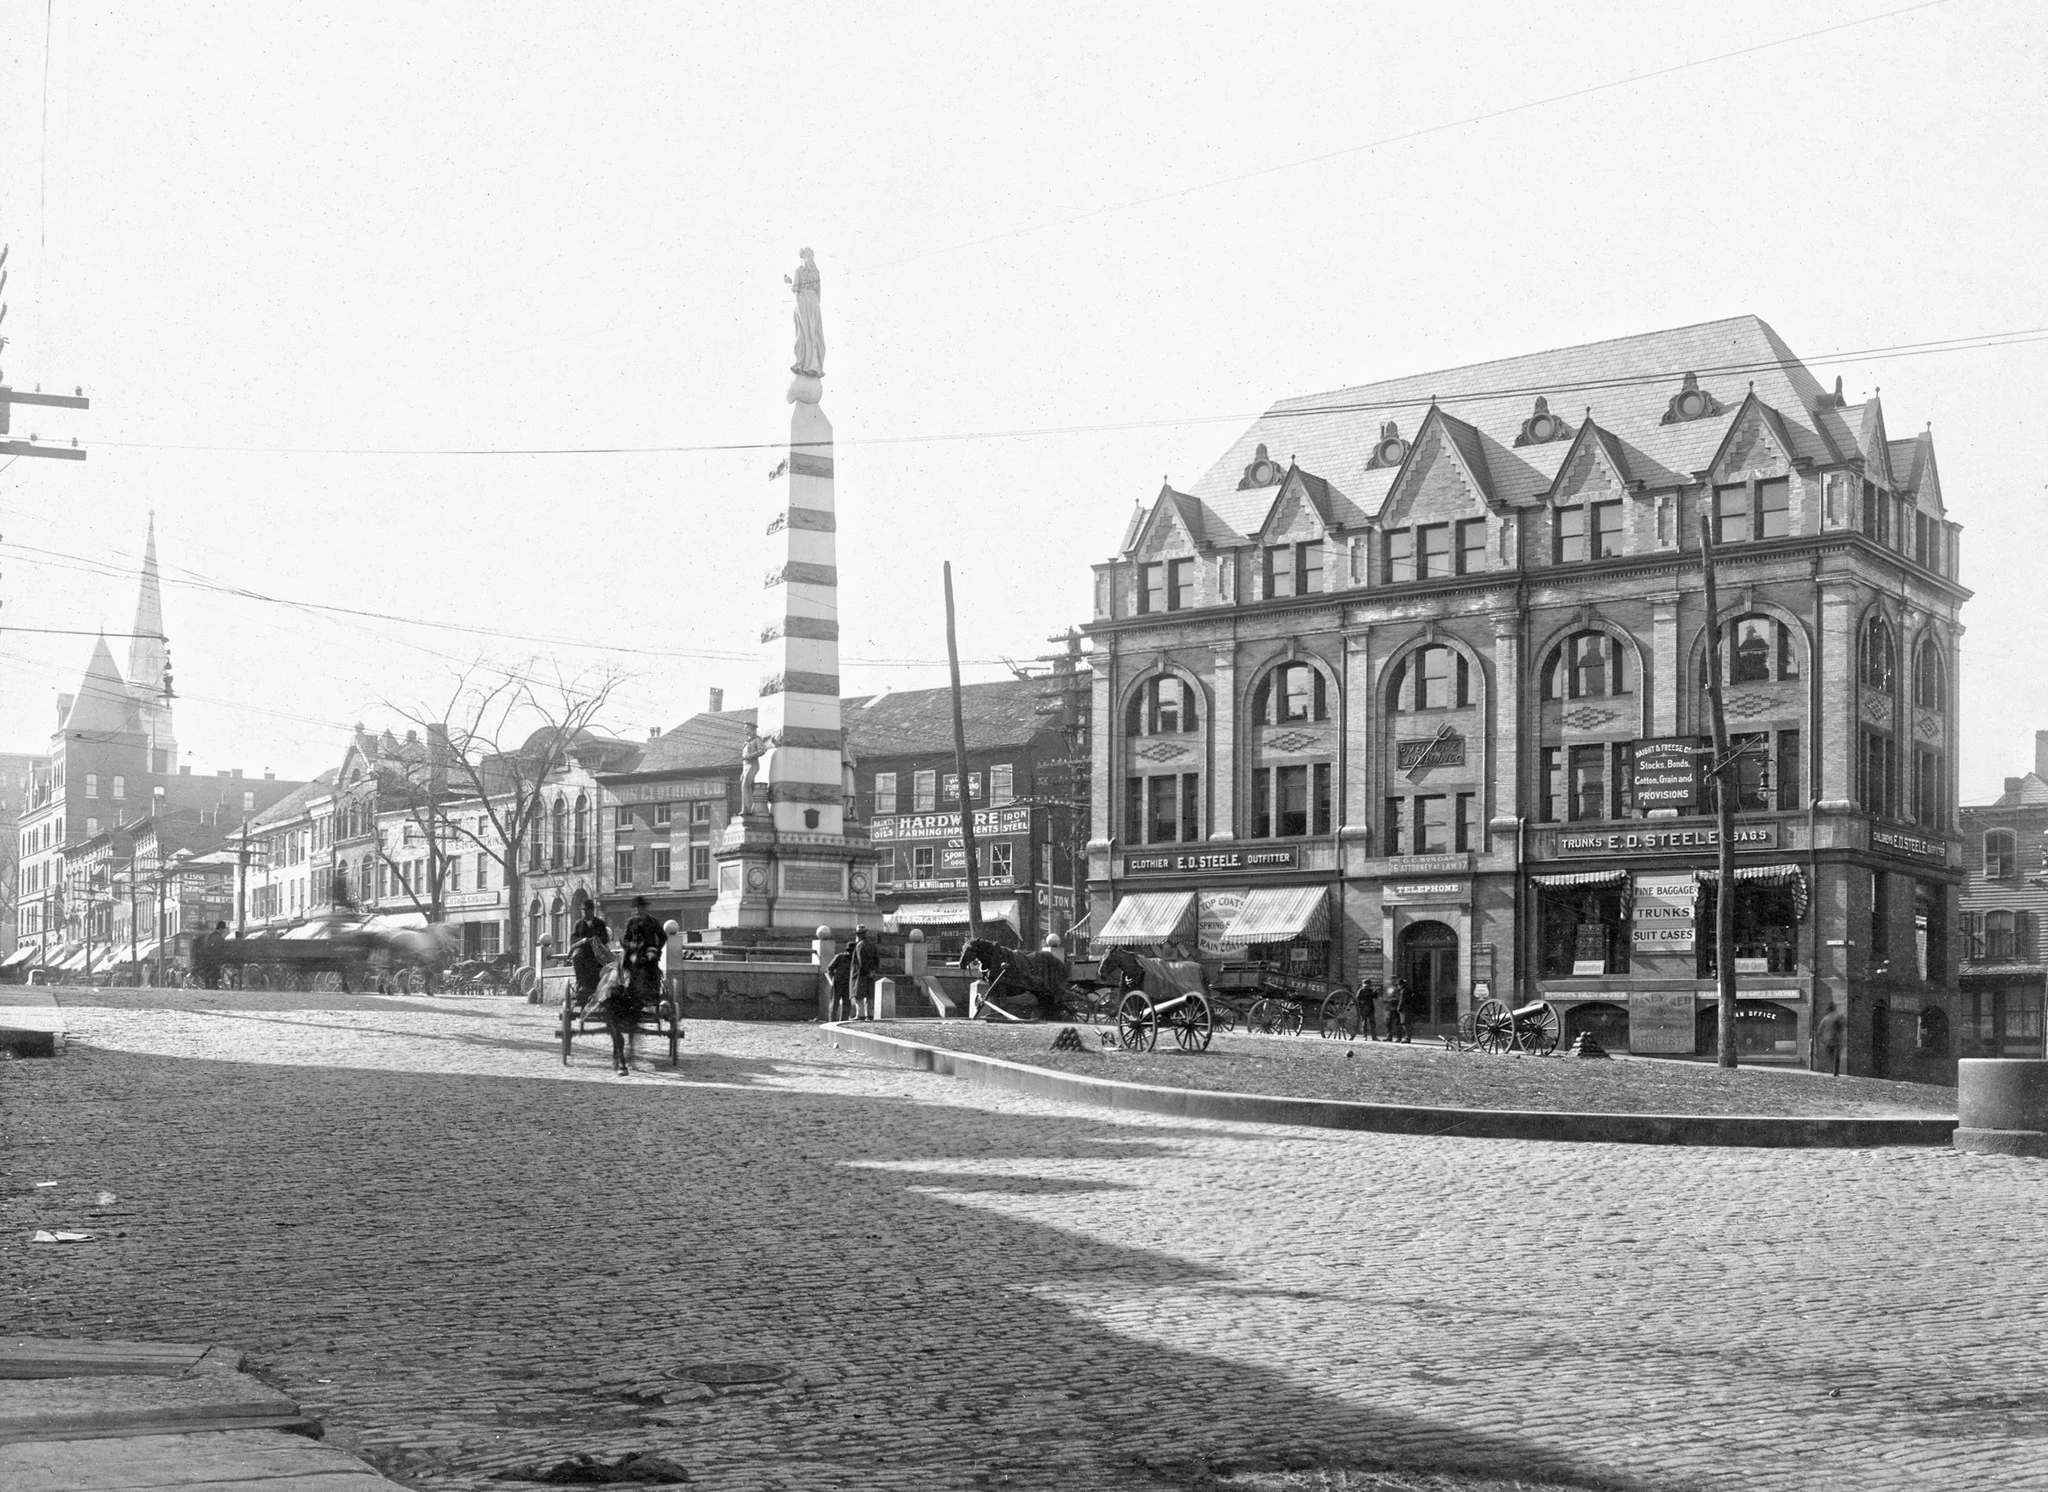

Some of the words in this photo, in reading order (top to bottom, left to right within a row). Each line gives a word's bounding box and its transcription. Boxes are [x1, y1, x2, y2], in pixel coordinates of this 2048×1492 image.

[1659, 774, 1678, 784] Grain
[1678, 772, 1693, 783] and
[640, 783, 701, 800] CLOTHING
[1638, 790, 1689, 800] PROVISIONS
[900, 812, 999, 829] HARDWRE
[1003, 810, 1027, 821] IRON
[873, 818, 895, 827] PAINTS
[1002, 822, 1028, 832] STEEL
[874, 829, 894, 839] OILS
[900, 828, 942, 838] FARMING
[1562, 838, 1602, 849] TRUNKS
[1645, 830, 1719, 847] STEELE
[1132, 858, 1169, 870] CLOTHIER
[1247, 852, 1292, 864] OUTFITTER
[1400, 862, 1433, 872] ATTORNEY
[1442, 862, 1457, 872] LAW
[1396, 884, 1459, 894] TELEPHONE
[1634, 886, 1654, 896] FINE
[1656, 885, 1695, 896] BAGGAGE
[1200, 898, 1216, 912] TOP
[1636, 907, 1690, 918] TRUNKS
[1199, 920, 1224, 930] SPRING
[1633, 931, 1658, 941] SUIT
[1660, 930, 1694, 940] CASES
[1200, 938, 1219, 951] RAIN
[1748, 1010, 1777, 1020] OFFICE
